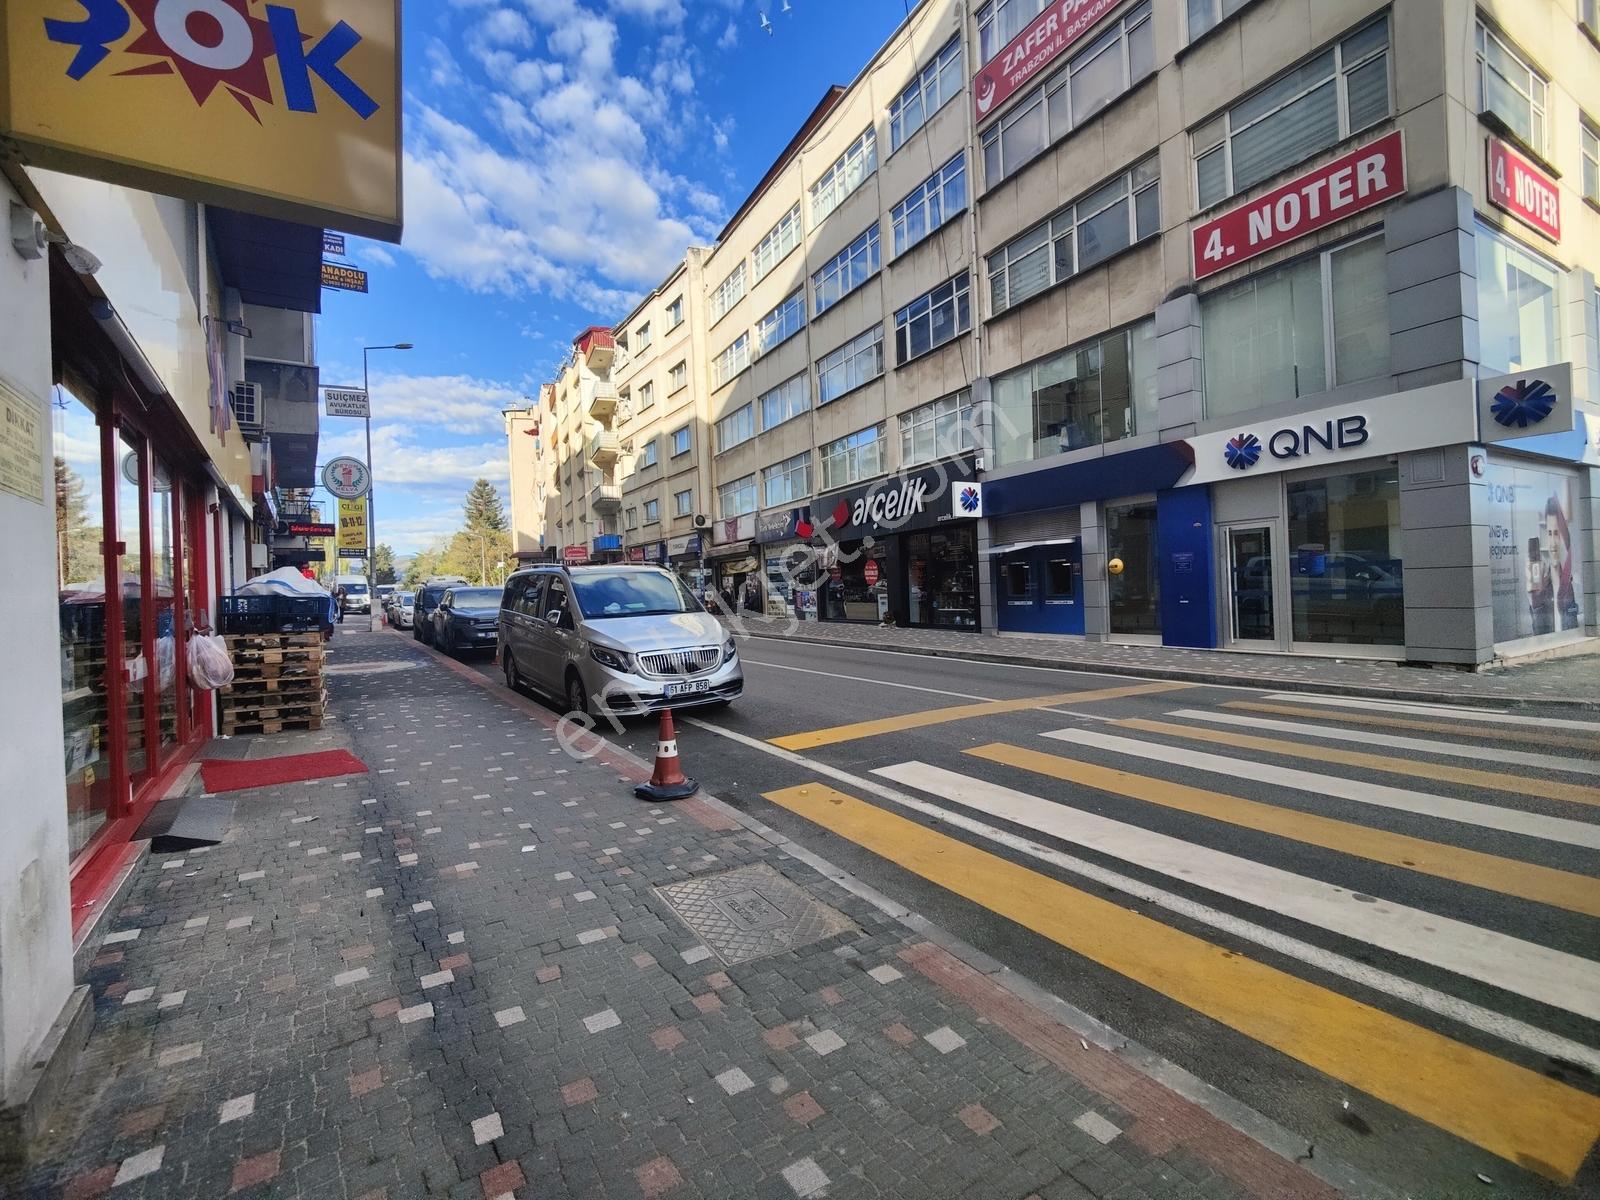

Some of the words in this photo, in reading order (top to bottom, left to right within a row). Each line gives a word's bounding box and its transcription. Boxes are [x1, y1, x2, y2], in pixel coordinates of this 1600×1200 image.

[1002, 12, 1059, 76] ZAFER
[1009, 42, 1055, 87] TRABZON
[1055, 34, 1065, 48] İL
[1203, 229, 1235, 262] 4.
[1248, 153, 1389, 246] NOTER
[1494, 155, 1511, 198] 4.
[1513, 165, 1559, 231] NOTER
[321, 266, 364, 280] ANADOLU
[327, 392, 368, 403] SUİÇMEZ
[1268, 414, 1370, 460] QNB
[852, 477, 927, 530] arçelik
[1495, 485, 1515, 504] QNB
[680, 684, 693, 693] AFP
[695, 682, 708, 691] 858
